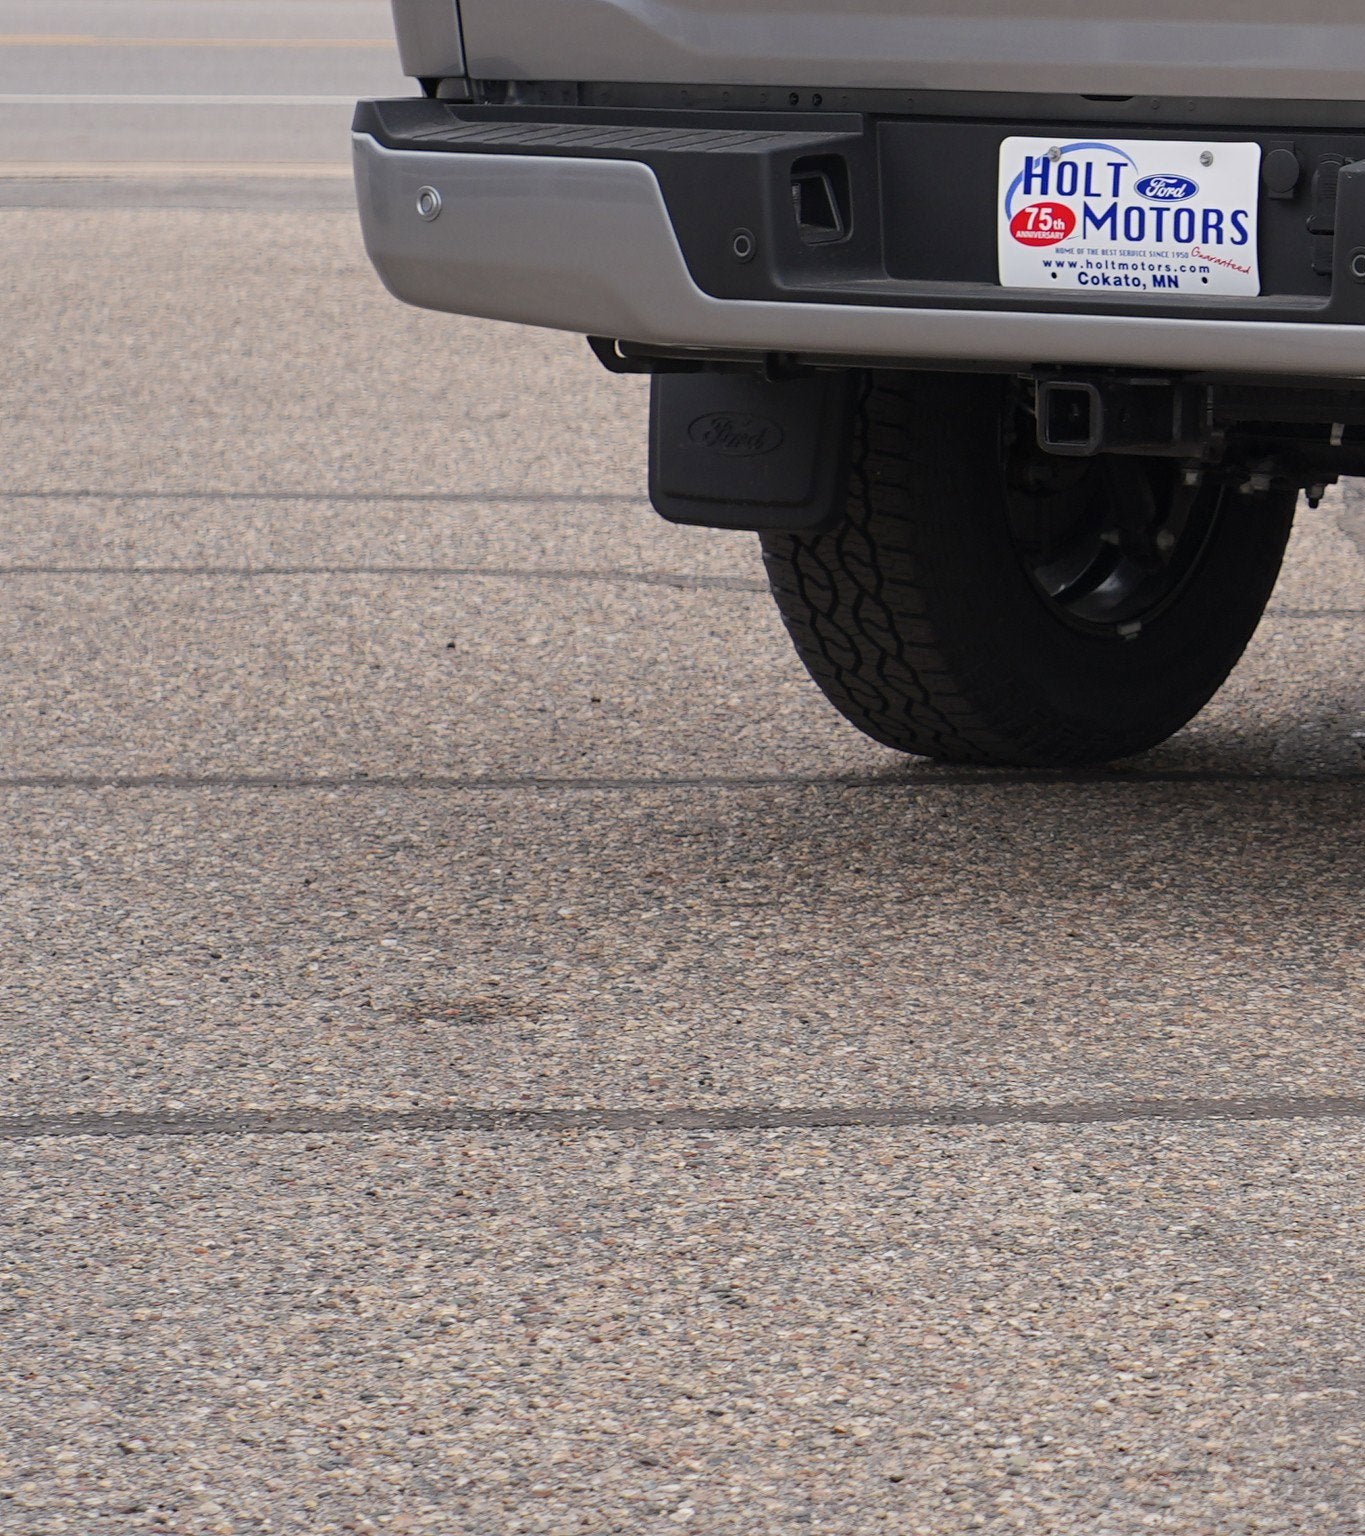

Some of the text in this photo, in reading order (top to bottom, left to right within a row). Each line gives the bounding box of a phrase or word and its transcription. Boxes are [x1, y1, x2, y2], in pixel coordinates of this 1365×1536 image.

[1022, 155, 1129, 198] HOLT
[1145, 177, 1187, 199] Ford
[1024, 207, 1066, 231] 75th
[1082, 200, 1250, 246] MOTORS
[1015, 230, 1065, 240] ANNIVERSARY
[1055, 247, 1189, 259] HOME OF THE BEST SERVICE SINCE 1950
[1191, 245, 1252, 276] Guaranteed
[1042, 258, 1211, 274] www.holtmotors.com
[1077, 271, 1180, 290] Cokato, MN
